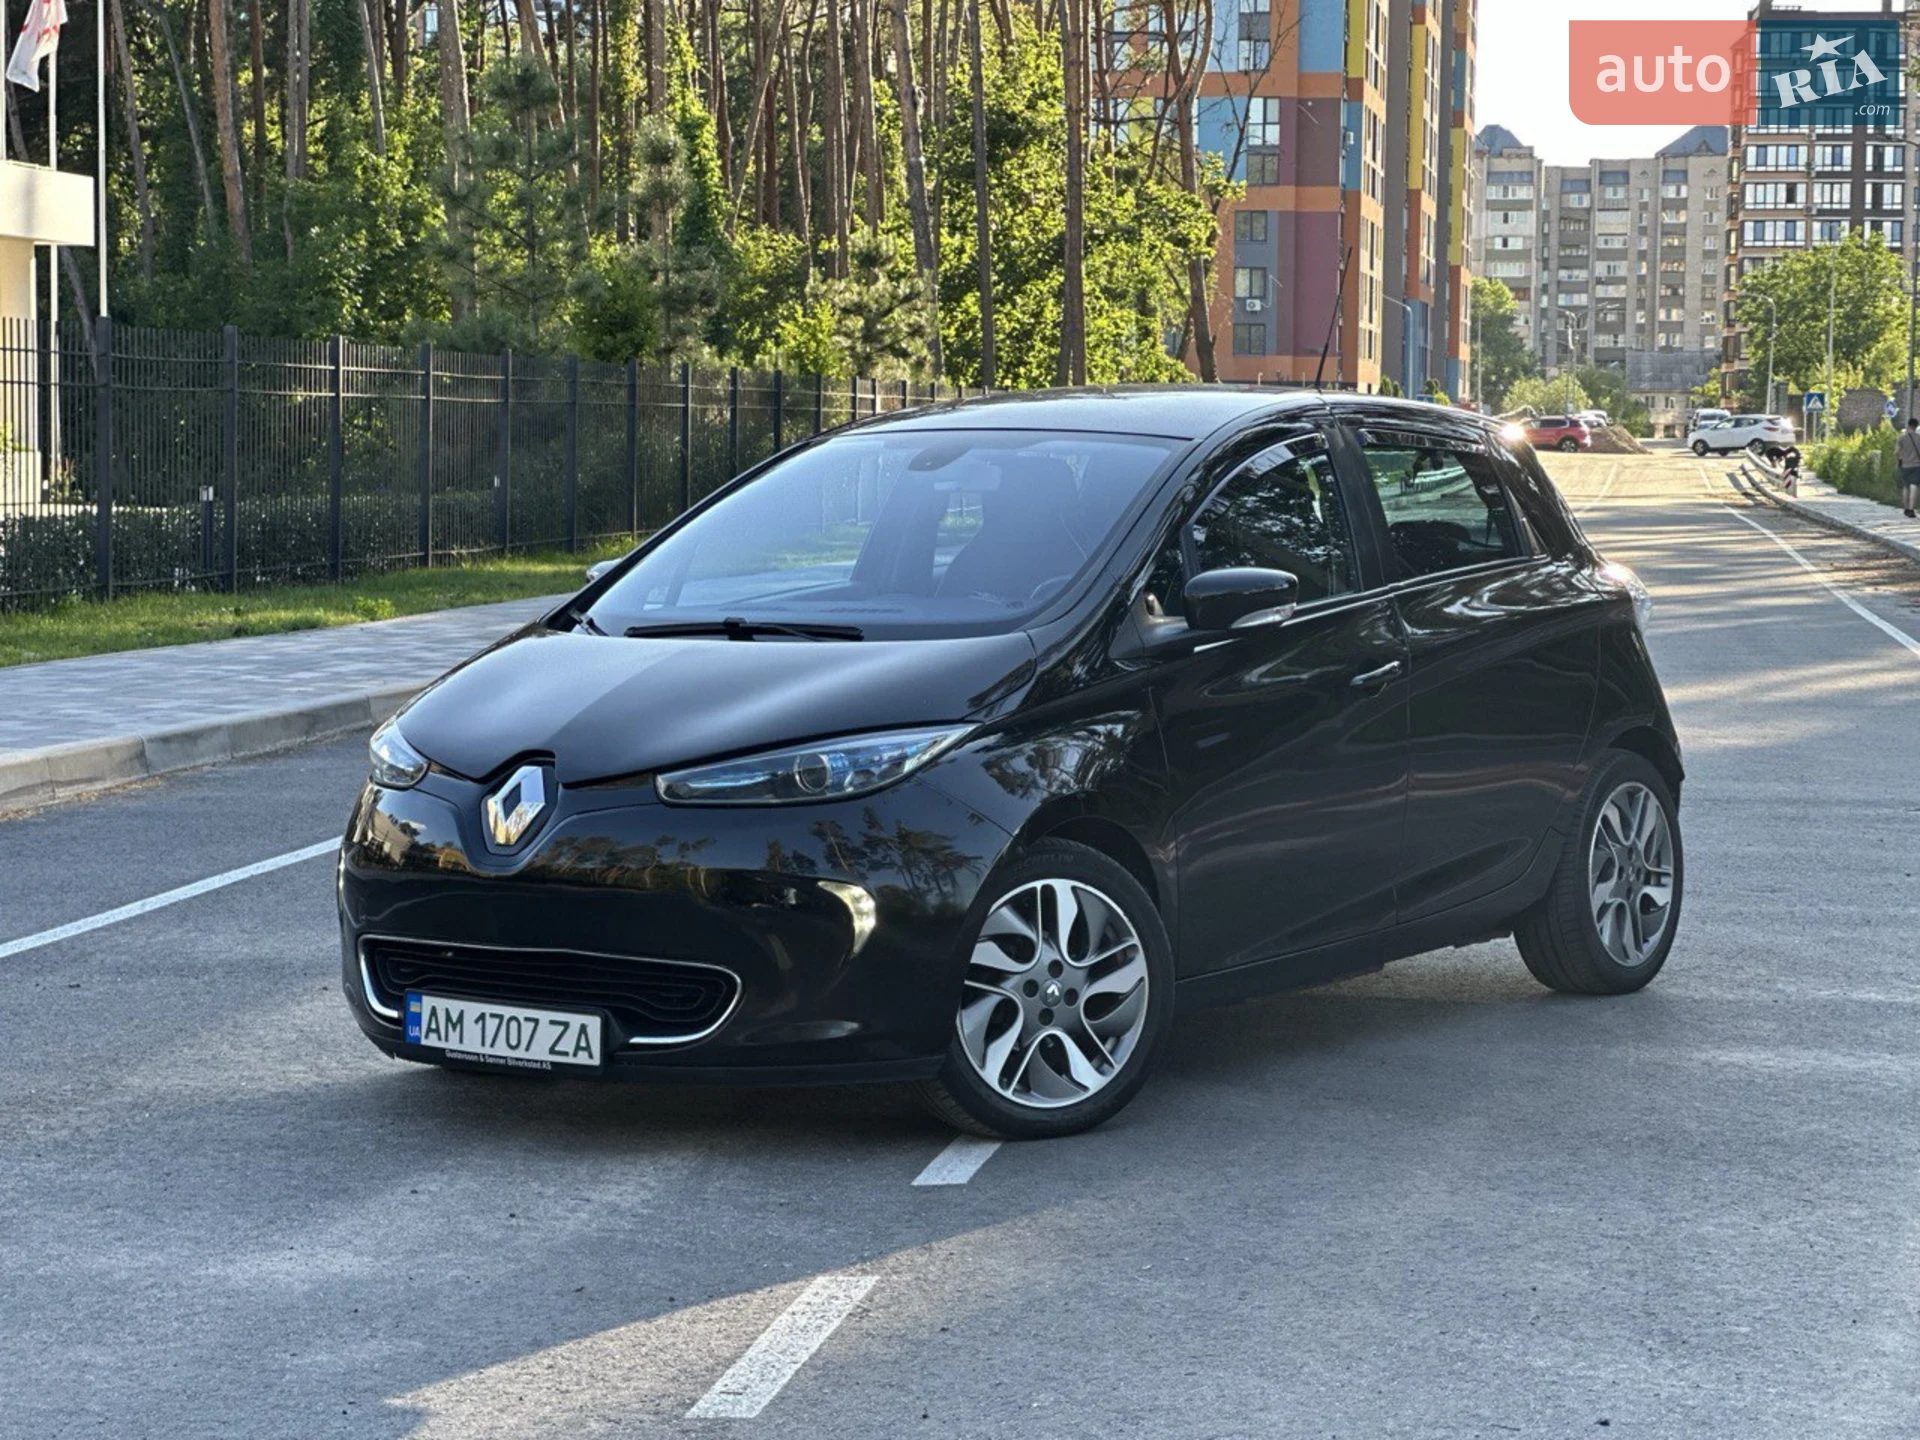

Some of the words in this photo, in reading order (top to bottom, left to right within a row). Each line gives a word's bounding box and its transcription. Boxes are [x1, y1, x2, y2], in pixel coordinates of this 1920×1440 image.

[408, 1026, 421, 1037] UA
[424, 1005, 464, 1044] AM
[474, 1012, 540, 1052] 1707
[548, 1019, 594, 1060] ZA
